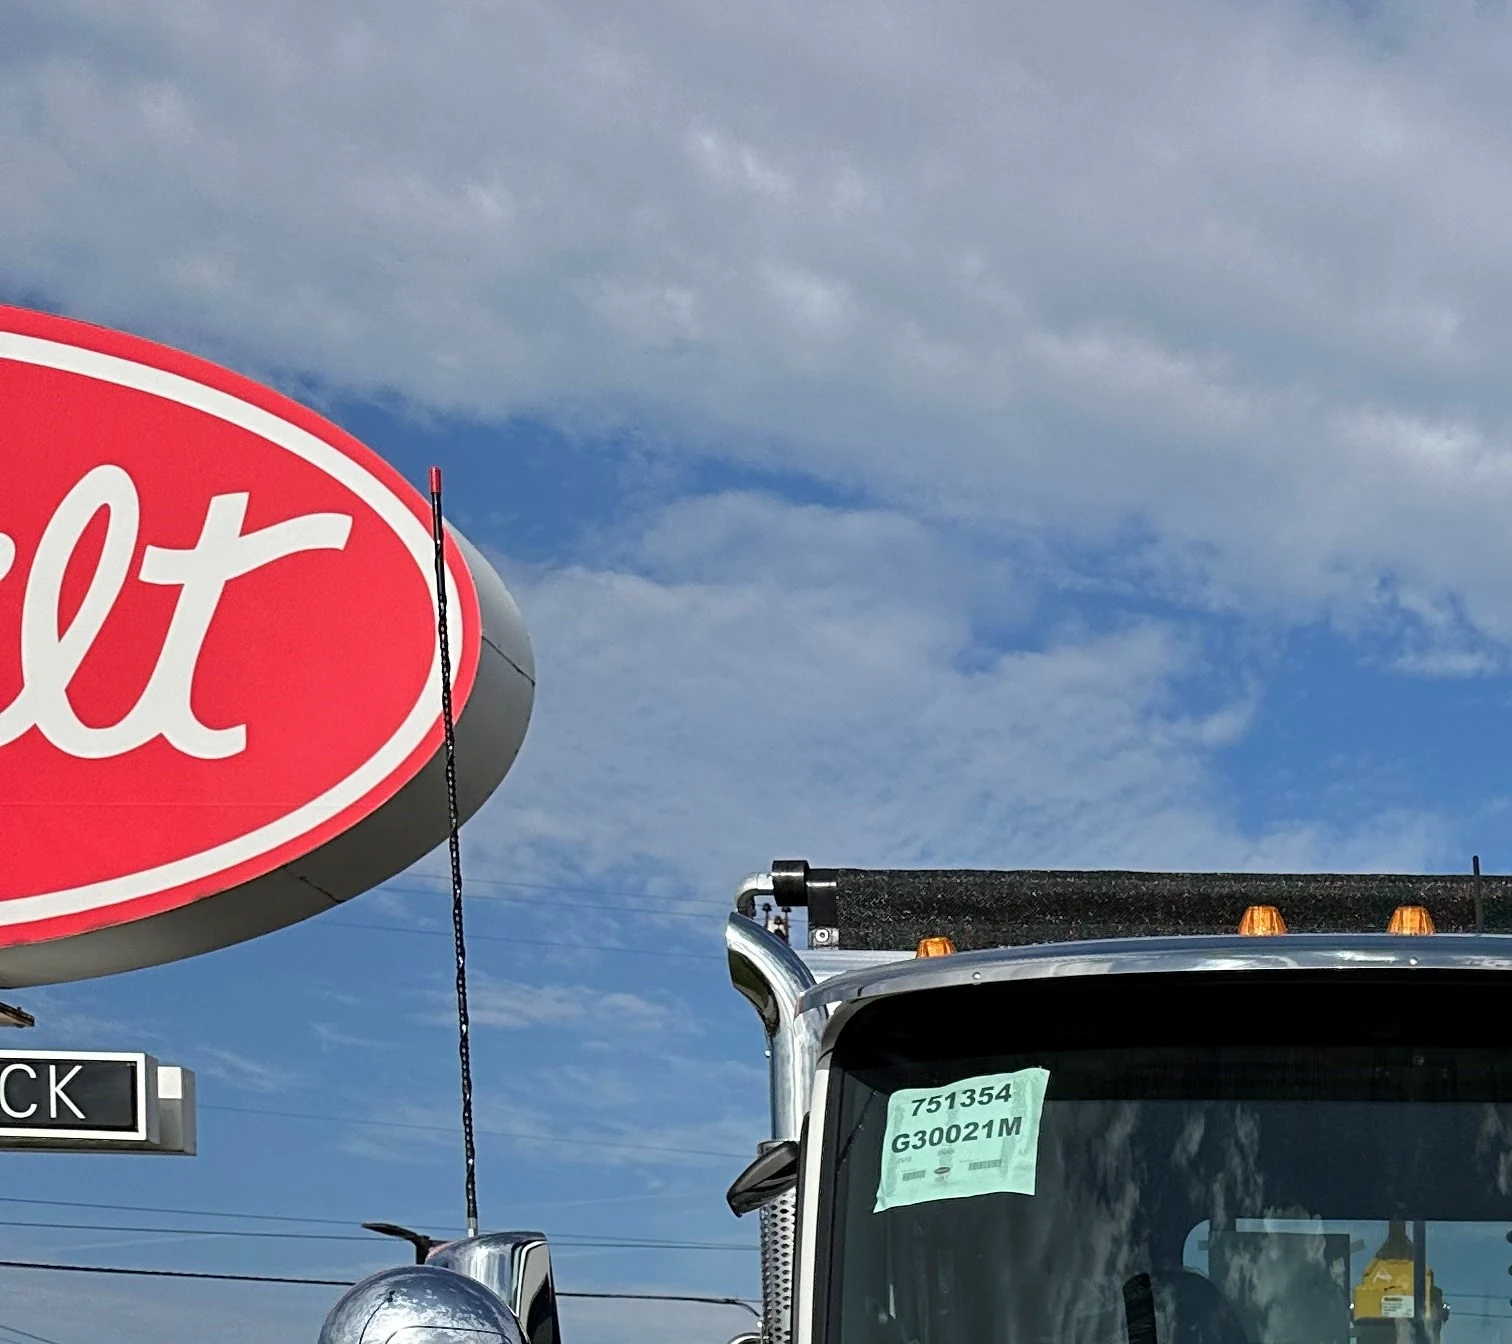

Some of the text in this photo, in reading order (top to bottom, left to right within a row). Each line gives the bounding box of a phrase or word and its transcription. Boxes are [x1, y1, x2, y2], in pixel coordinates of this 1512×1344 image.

[0, 464, 353, 760] lt
[0, 1063, 86, 1119] CK
[911, 1083, 1012, 1117] 751354
[891, 1116, 1023, 1154] G30021M
